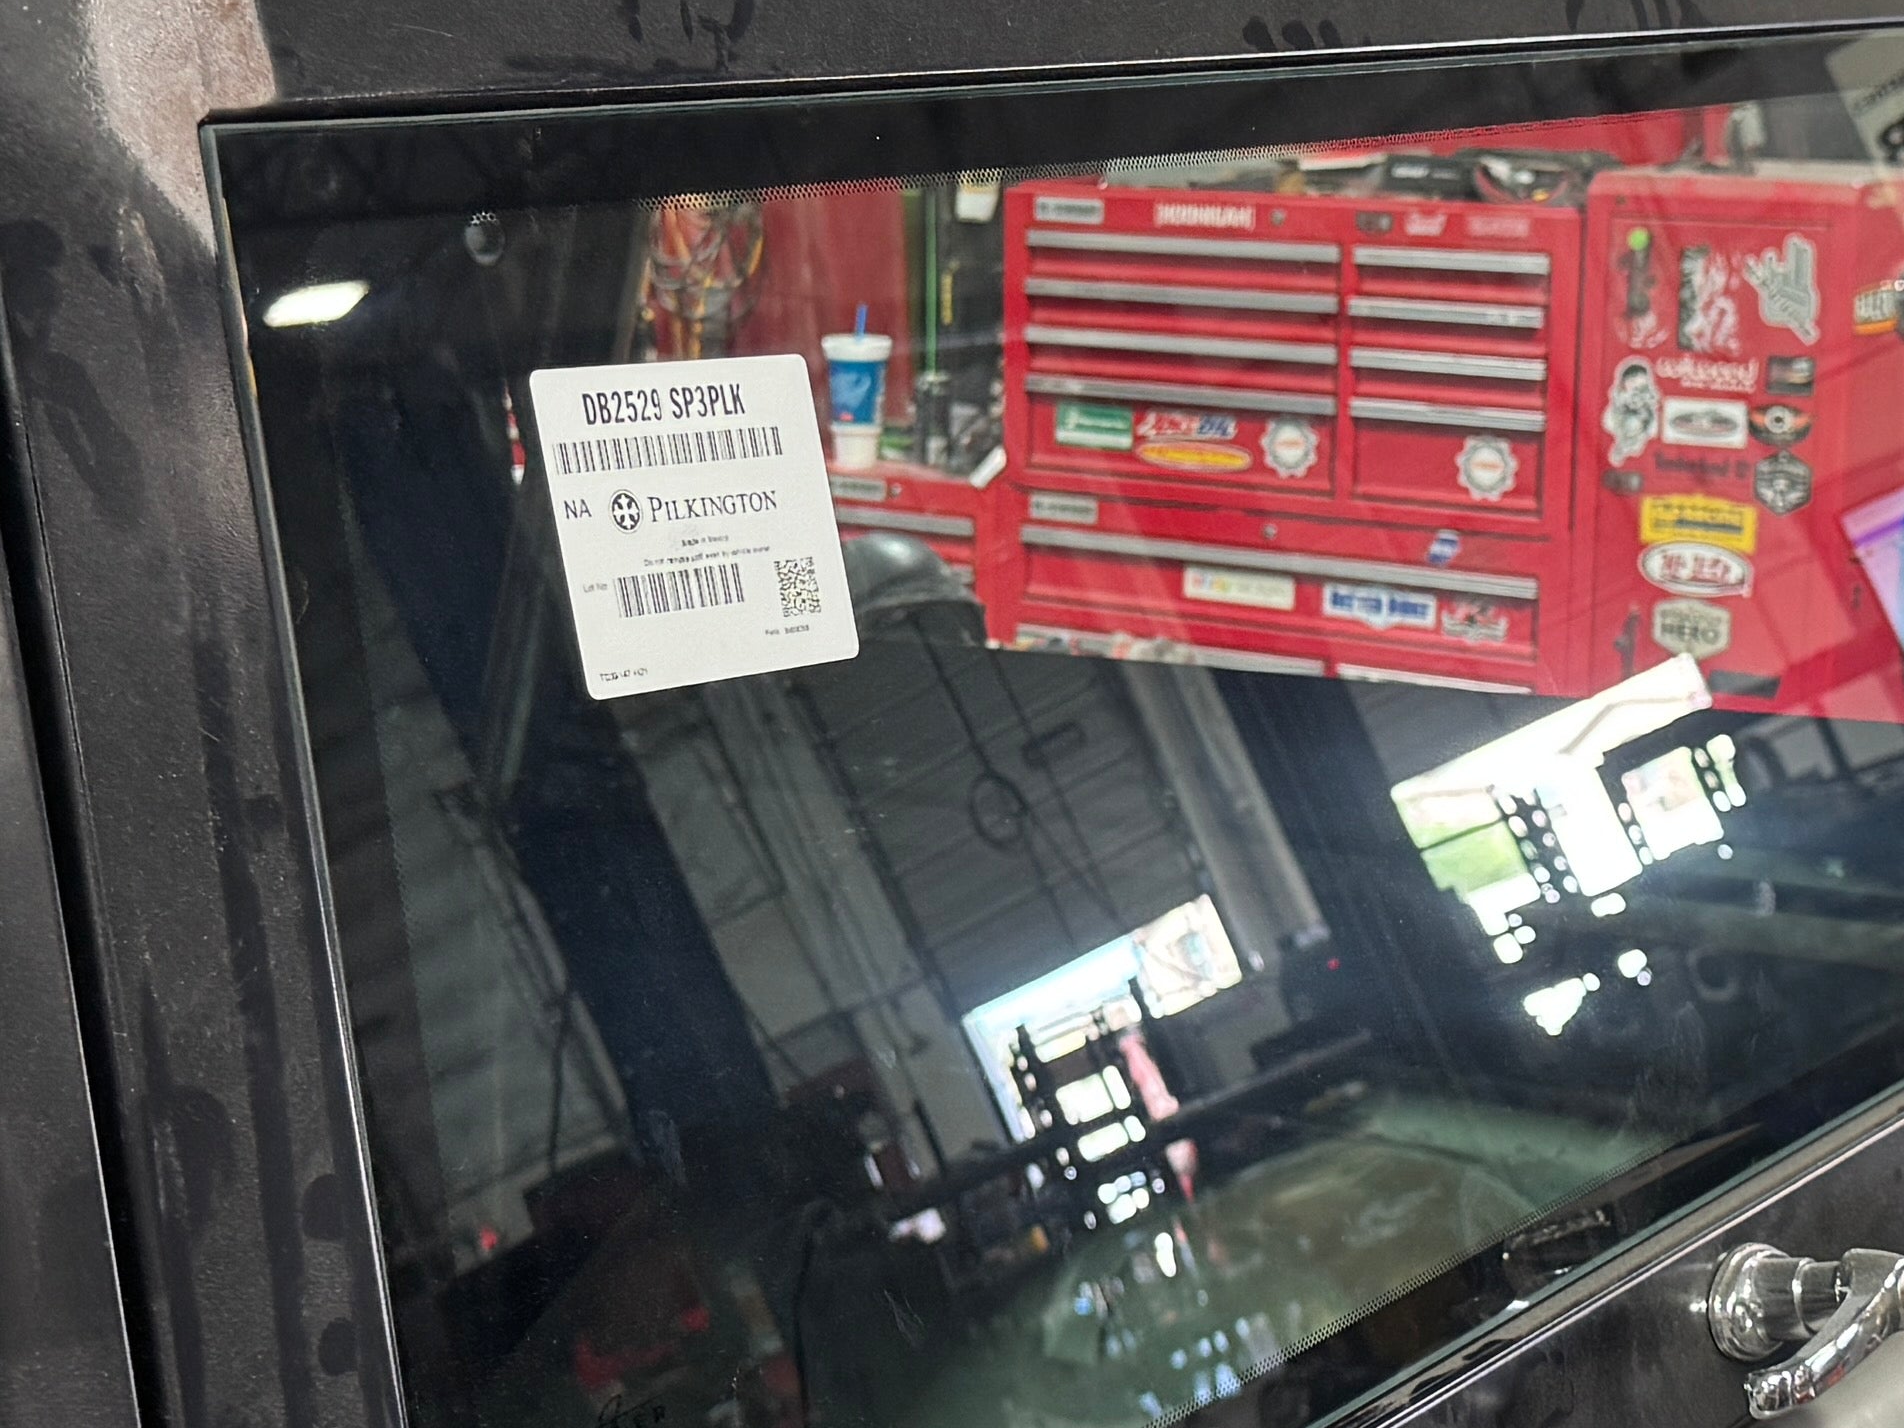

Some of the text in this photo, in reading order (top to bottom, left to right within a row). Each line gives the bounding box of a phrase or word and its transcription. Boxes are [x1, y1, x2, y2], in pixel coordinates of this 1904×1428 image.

[582, 383, 746, 425] DB2529 SP3PLK
[563, 490, 778, 523] NA PILKINGTON
